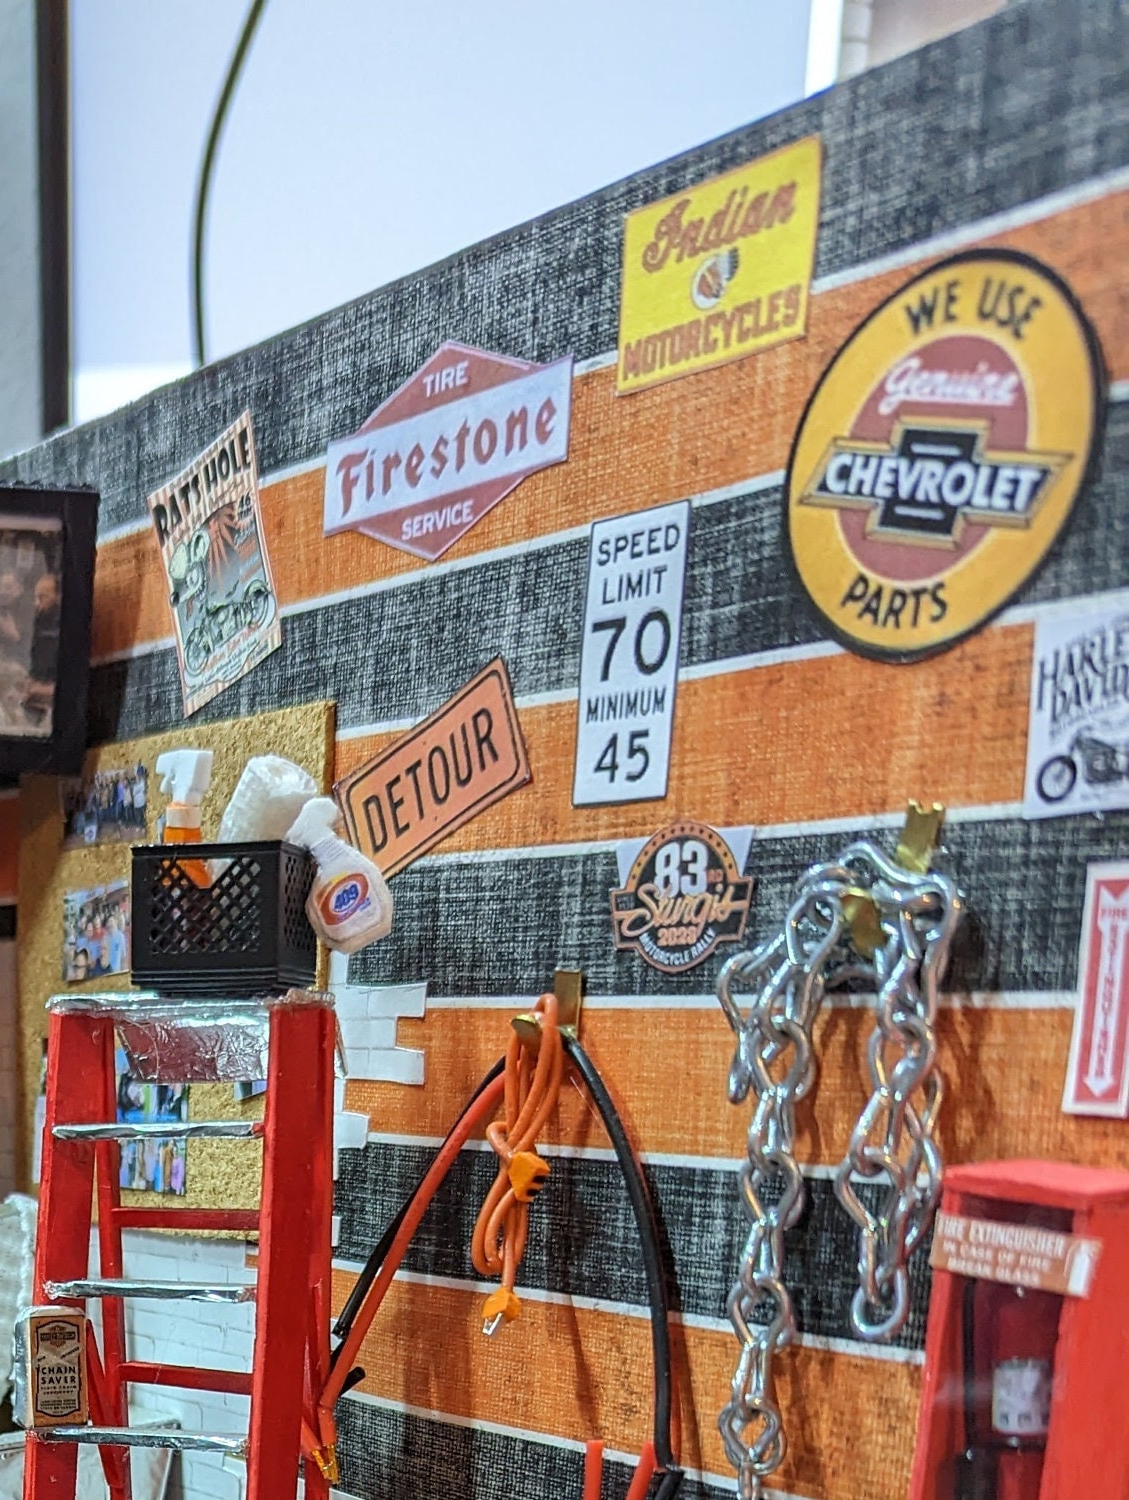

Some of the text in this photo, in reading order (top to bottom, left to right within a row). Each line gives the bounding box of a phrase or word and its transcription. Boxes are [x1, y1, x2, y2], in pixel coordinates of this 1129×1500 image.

[642, 180, 796, 273] Indian
[622, 283, 801, 382] MOTORCYCLES
[905, 276, 1043, 341] WE USE
[423, 361, 469, 397] TIRE
[878, 358, 1018, 414] Genuine
[204, 427, 251, 494] HOLE
[336, 396, 558, 517] Firestone
[825, 454, 1042, 512] CHEVROLET
[401, 500, 474, 541] SERVICE
[597, 523, 680, 567] SPEED
[601, 565, 668, 605] LIMIT
[840, 574, 948, 630] PARTS
[591, 608, 671, 683] 70
[586, 686, 667, 724] MINIMUM
[362, 707, 501, 855] DETOUR
[593, 729, 651, 784] 45
[334, 883, 359, 909] 409
[654, 839, 709, 899] 83
[619, 883, 749, 938] Sturgis
[639, 927, 716, 965] MOTORCYCLE RALLY
[937, 1214, 1065, 1258] FIRE EXTINGUISHER
[41, 1366, 76, 1375] CHAIN
[41, 1376, 76, 1385] SAVER
